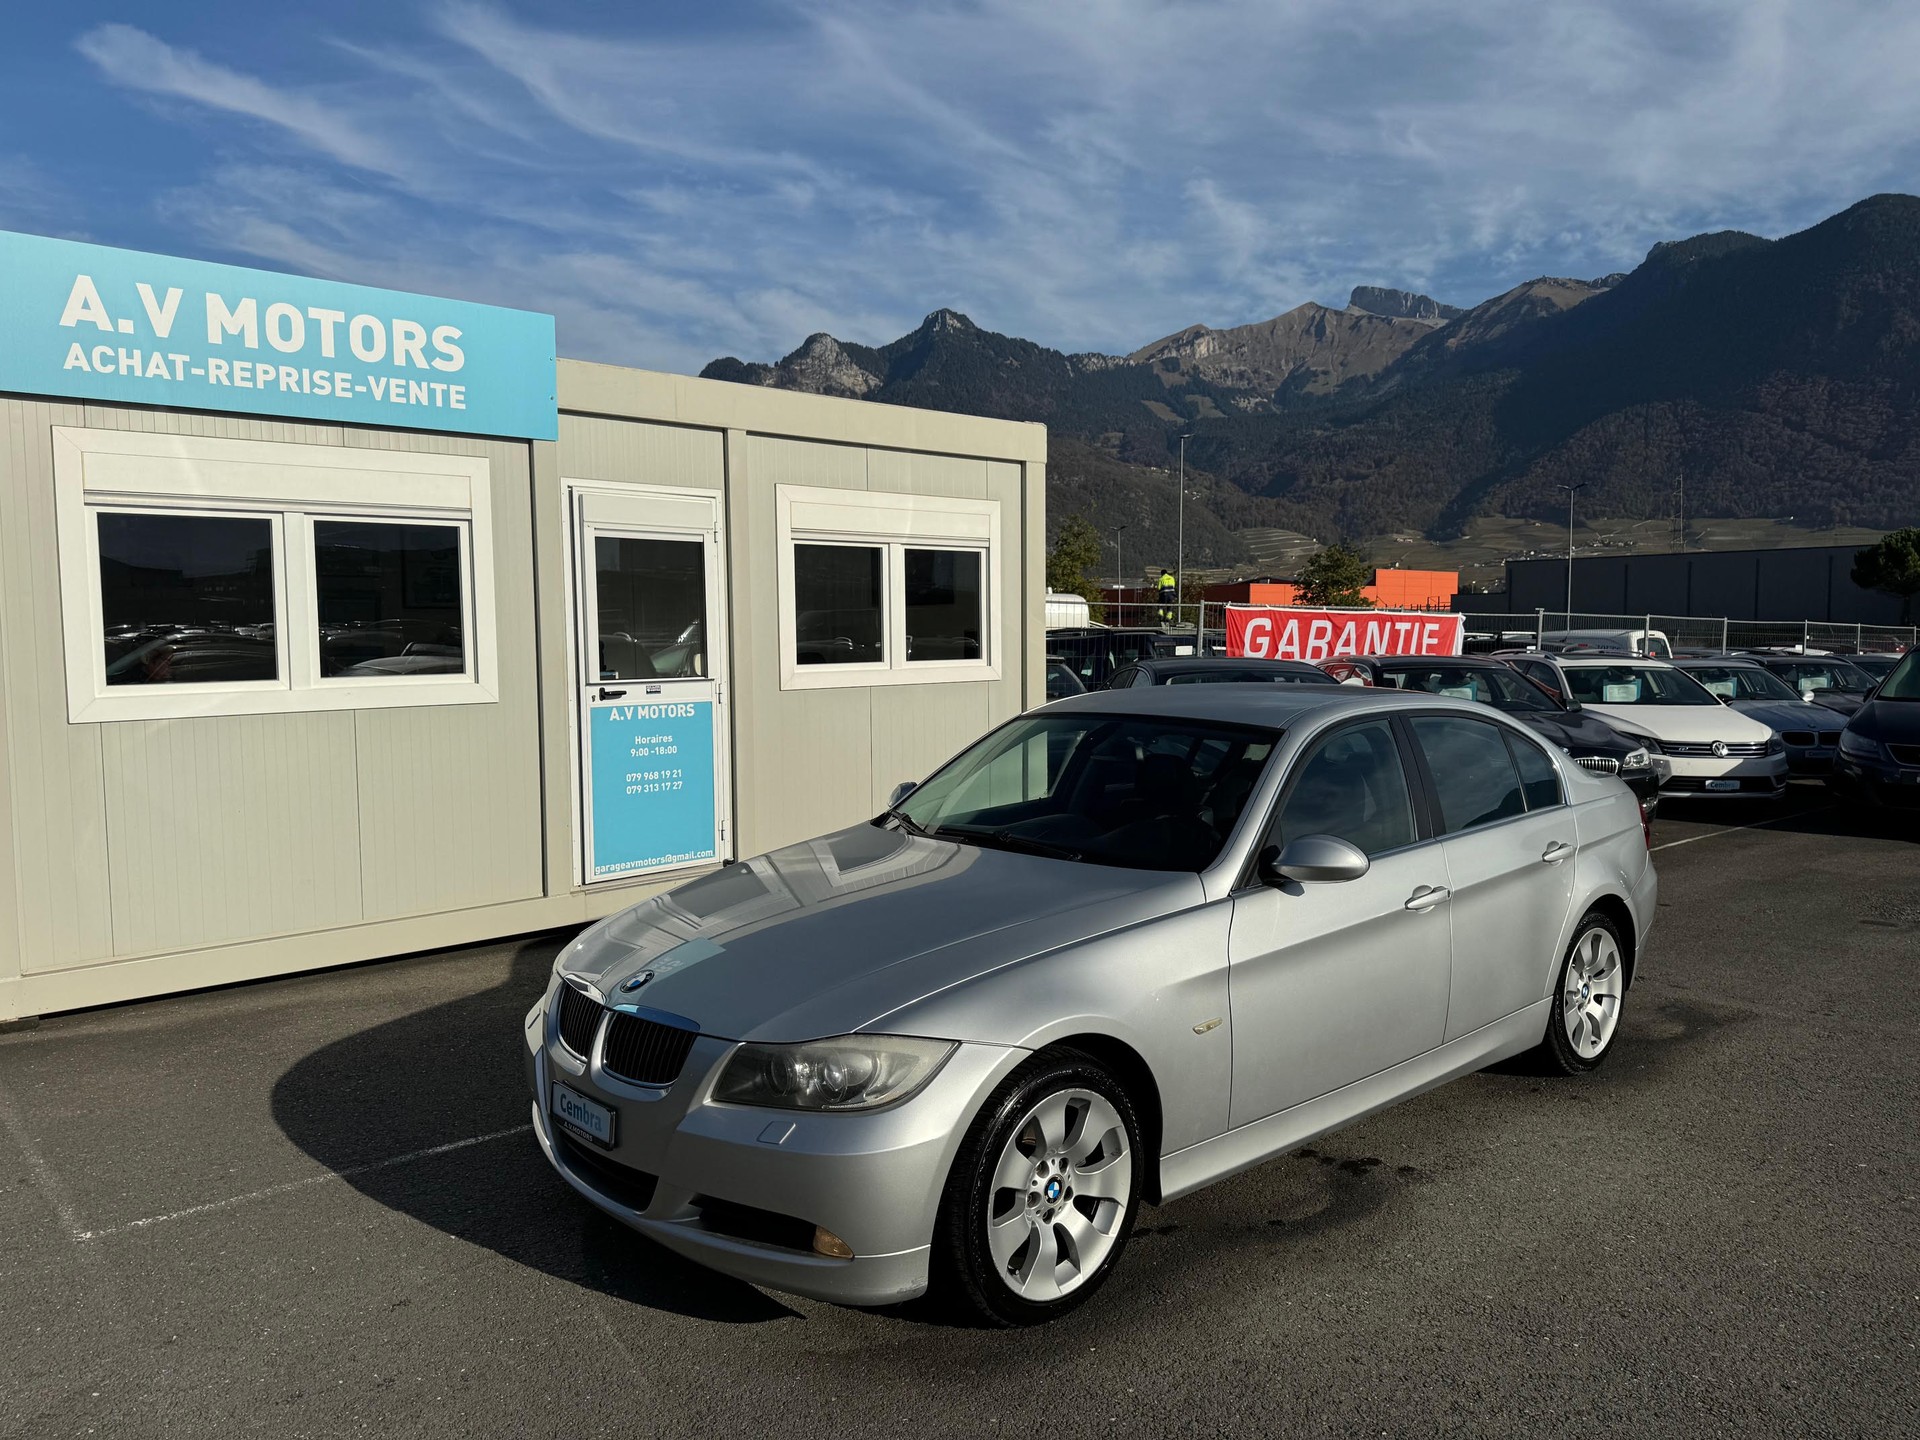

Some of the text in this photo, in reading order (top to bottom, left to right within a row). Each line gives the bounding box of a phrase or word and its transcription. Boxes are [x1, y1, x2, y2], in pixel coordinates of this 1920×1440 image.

[59, 274, 465, 373] A.V MOTORS
[63, 342, 466, 410] ACHAT-REPRISE-VENTE
[1243, 617, 1440, 664] GARANTIE
[609, 704, 695, 721] A.V MOTORS
[635, 734, 673, 745] Horaires
[630, 748, 649, 757] 9:00
[626, 769, 682, 782] 079 968 19 21
[626, 781, 683, 795] 079 313 17 27
[595, 849, 714, 875] garageavmotors@gmail.com
[560, 1093, 603, 1132] Cembra
